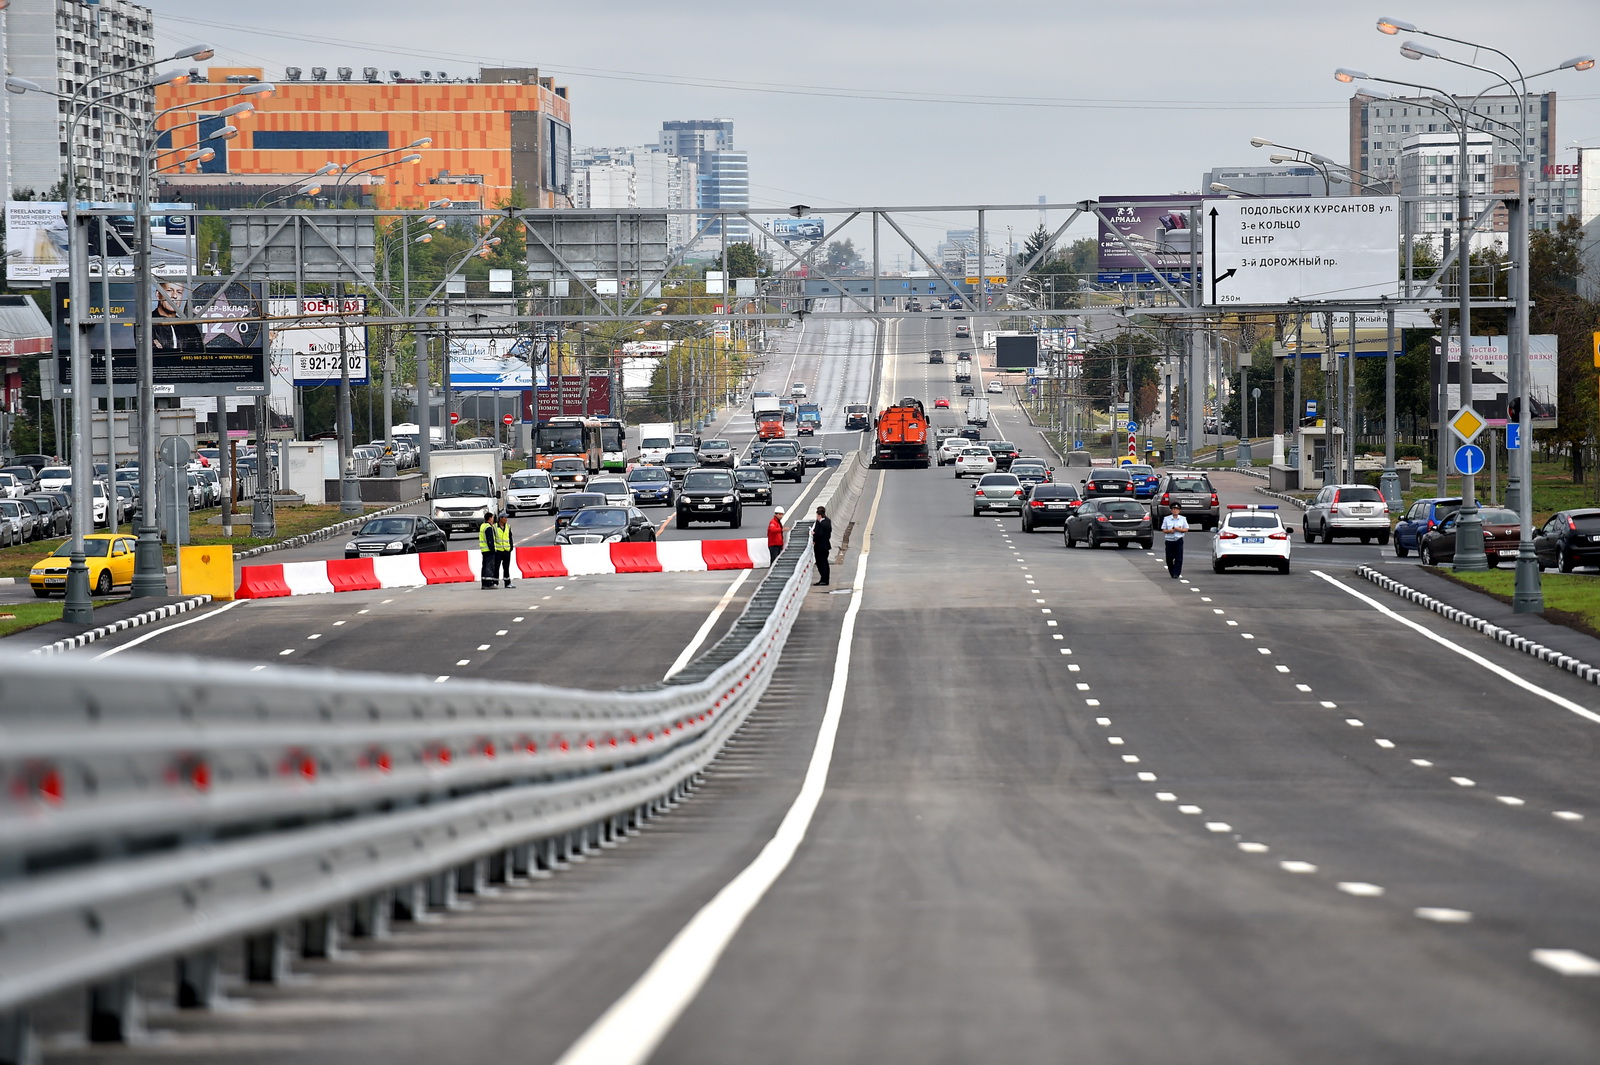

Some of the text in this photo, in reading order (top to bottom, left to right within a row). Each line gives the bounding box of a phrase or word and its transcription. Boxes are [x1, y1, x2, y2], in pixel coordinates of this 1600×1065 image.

[1543, 165, 1579, 174] МЕБЕ
[1240, 203, 1393, 215] ПОДОЛЬСКИХ КУРСАНТОВ ул.
[1241, 219, 1300, 230] 3-е КОЛЬЦО
[1241, 235, 1275, 245] ЦЕНТР
[1242, 254, 1338, 267] 3-й ДОРОЖНЫЙ пр.
[302, 301, 360, 312] ВОЕНАЯ
[200, 313, 249, 334] 12%
[1339, 315, 1382, 323] ДООЖНЫЙ
[309, 357, 361, 370] 921-2202
